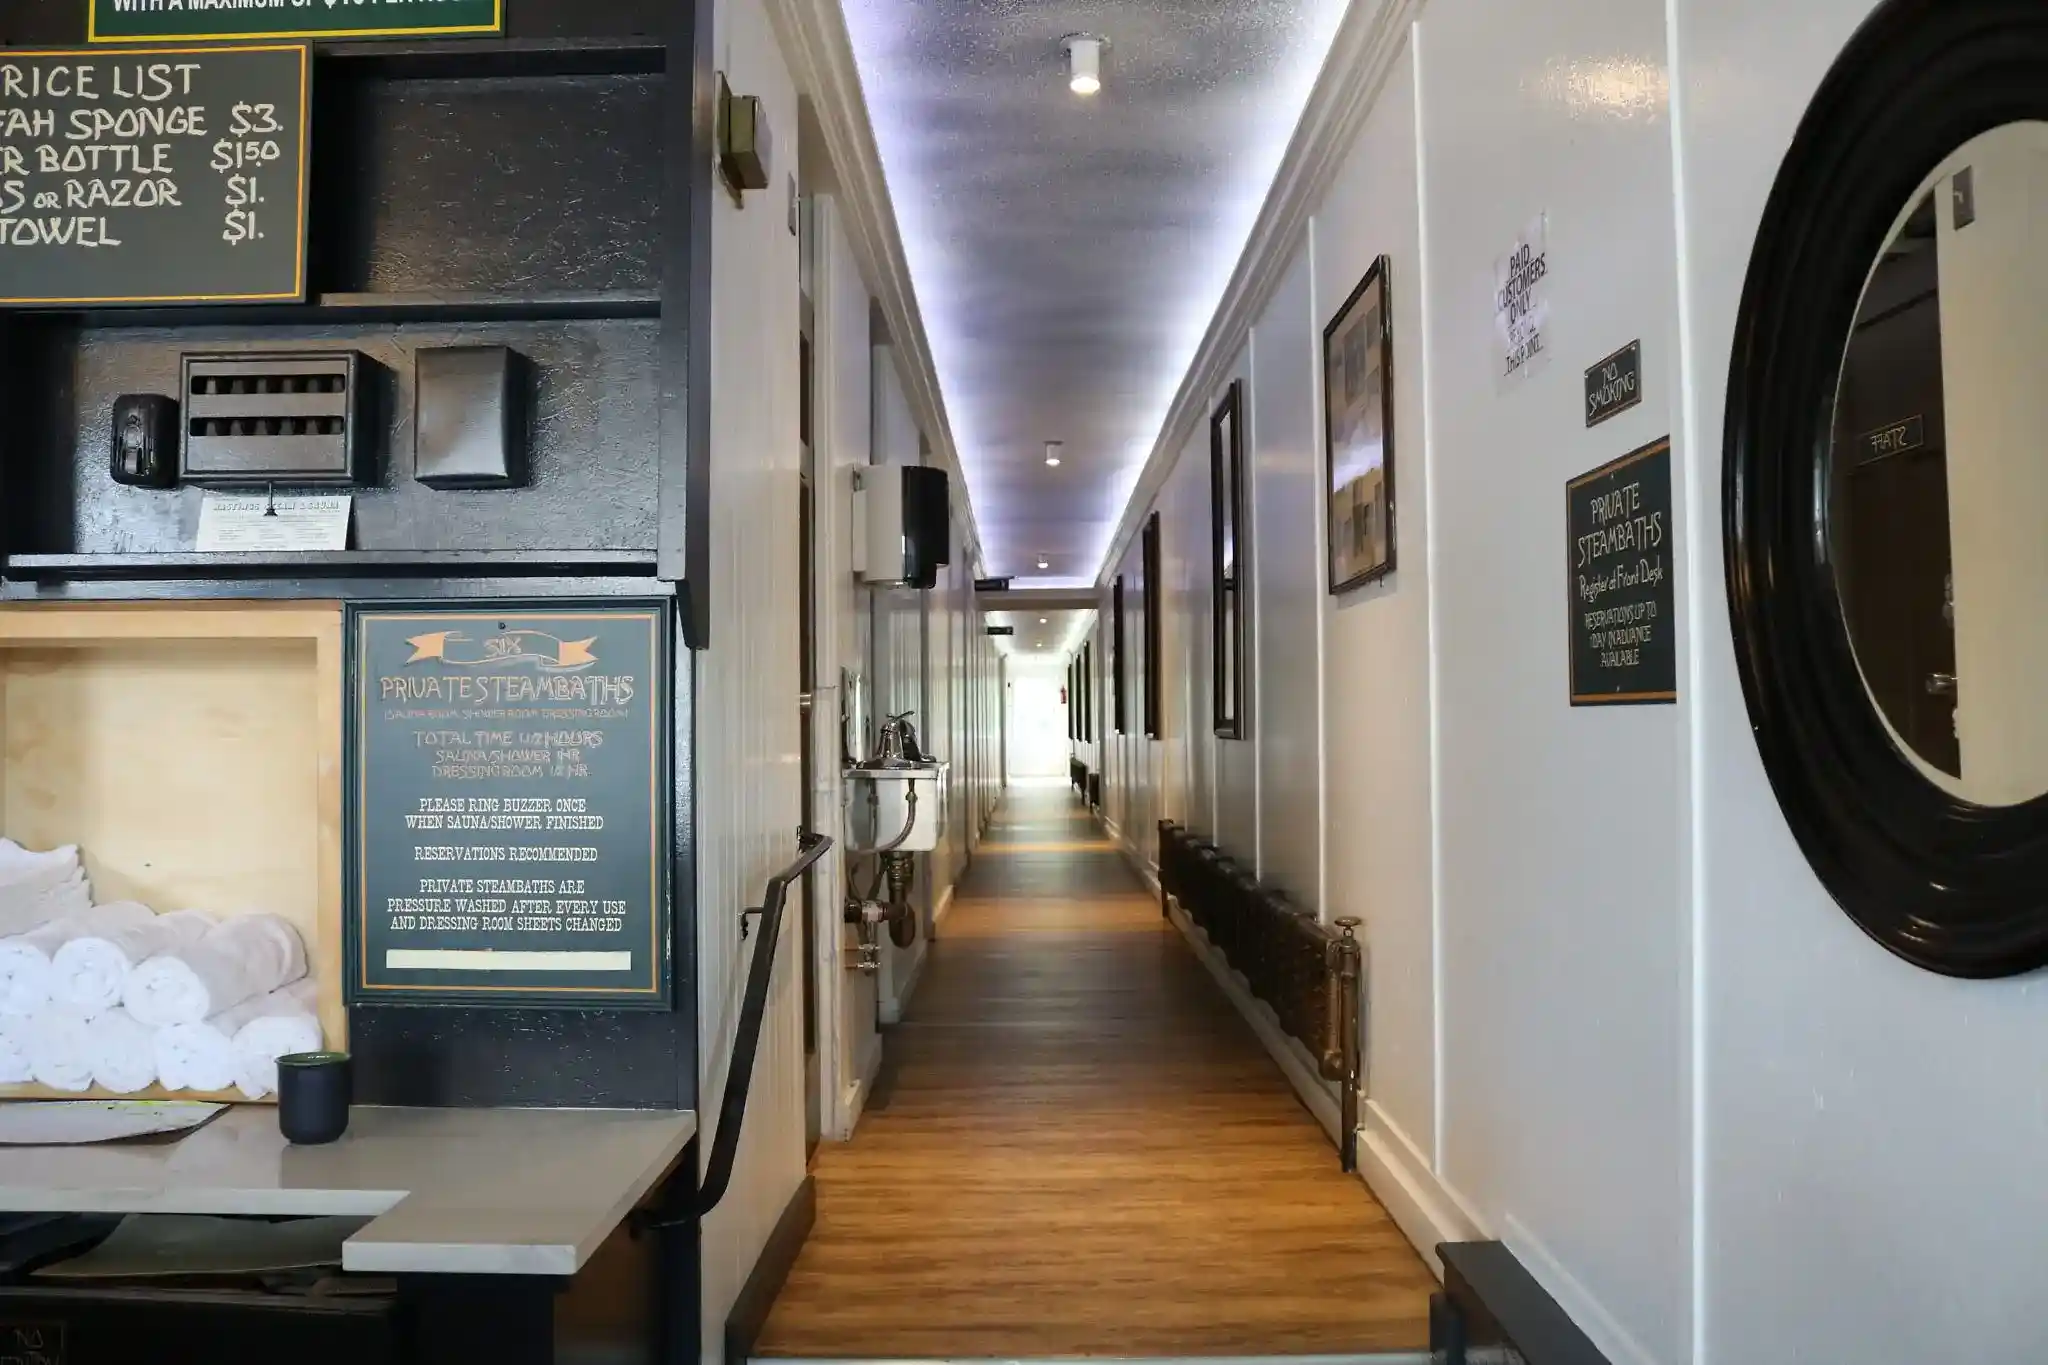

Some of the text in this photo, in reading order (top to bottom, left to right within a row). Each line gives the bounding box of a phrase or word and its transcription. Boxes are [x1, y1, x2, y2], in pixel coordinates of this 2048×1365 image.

[113, 64, 201, 101] LIST
[65, 106, 207, 140] SPONGE
[35, 144, 173, 174] BOTTLE
[33, 191, 62, 210] OR
[64, 177, 182, 209] RAZOR
[0, 216, 122, 247] TOWEL
[1510, 243, 1530, 277] PAID
[1498, 252, 1547, 312] CUSTOMERS
[1509, 290, 1531, 325] ONLY
[1601, 362, 1618, 381] NO
[1588, 371, 1635, 417] SMOKING
[1590, 482, 1640, 526] PRIVATE
[1578, 511, 1662, 568] STEAMBATHS
[1579, 554, 1664, 603] Register at Front Desk
[1645, 600, 1657, 620] TO
[381, 675, 634, 706] PRIVATE STEAMBATHS
[412, 730, 472, 748] TOTAL
[474, 730, 512, 748] TIME
[544, 730, 603, 748] HOURS
[420, 797, 587, 813] PLEASE RING BUZZER ONCE
[404, 814, 604, 830] WHEN SAUNA/SHOWER FINISHED
[414, 846, 506, 861] RESERVATIONS
[420, 879, 585, 894] PRIVATE STEAMBATHS ARE
[387, 898, 626, 915] PRESSURE WASHED AFTER EVERY USE
[390, 915, 622, 932] AND DRESSING ROOM SHEETS CHANGED
